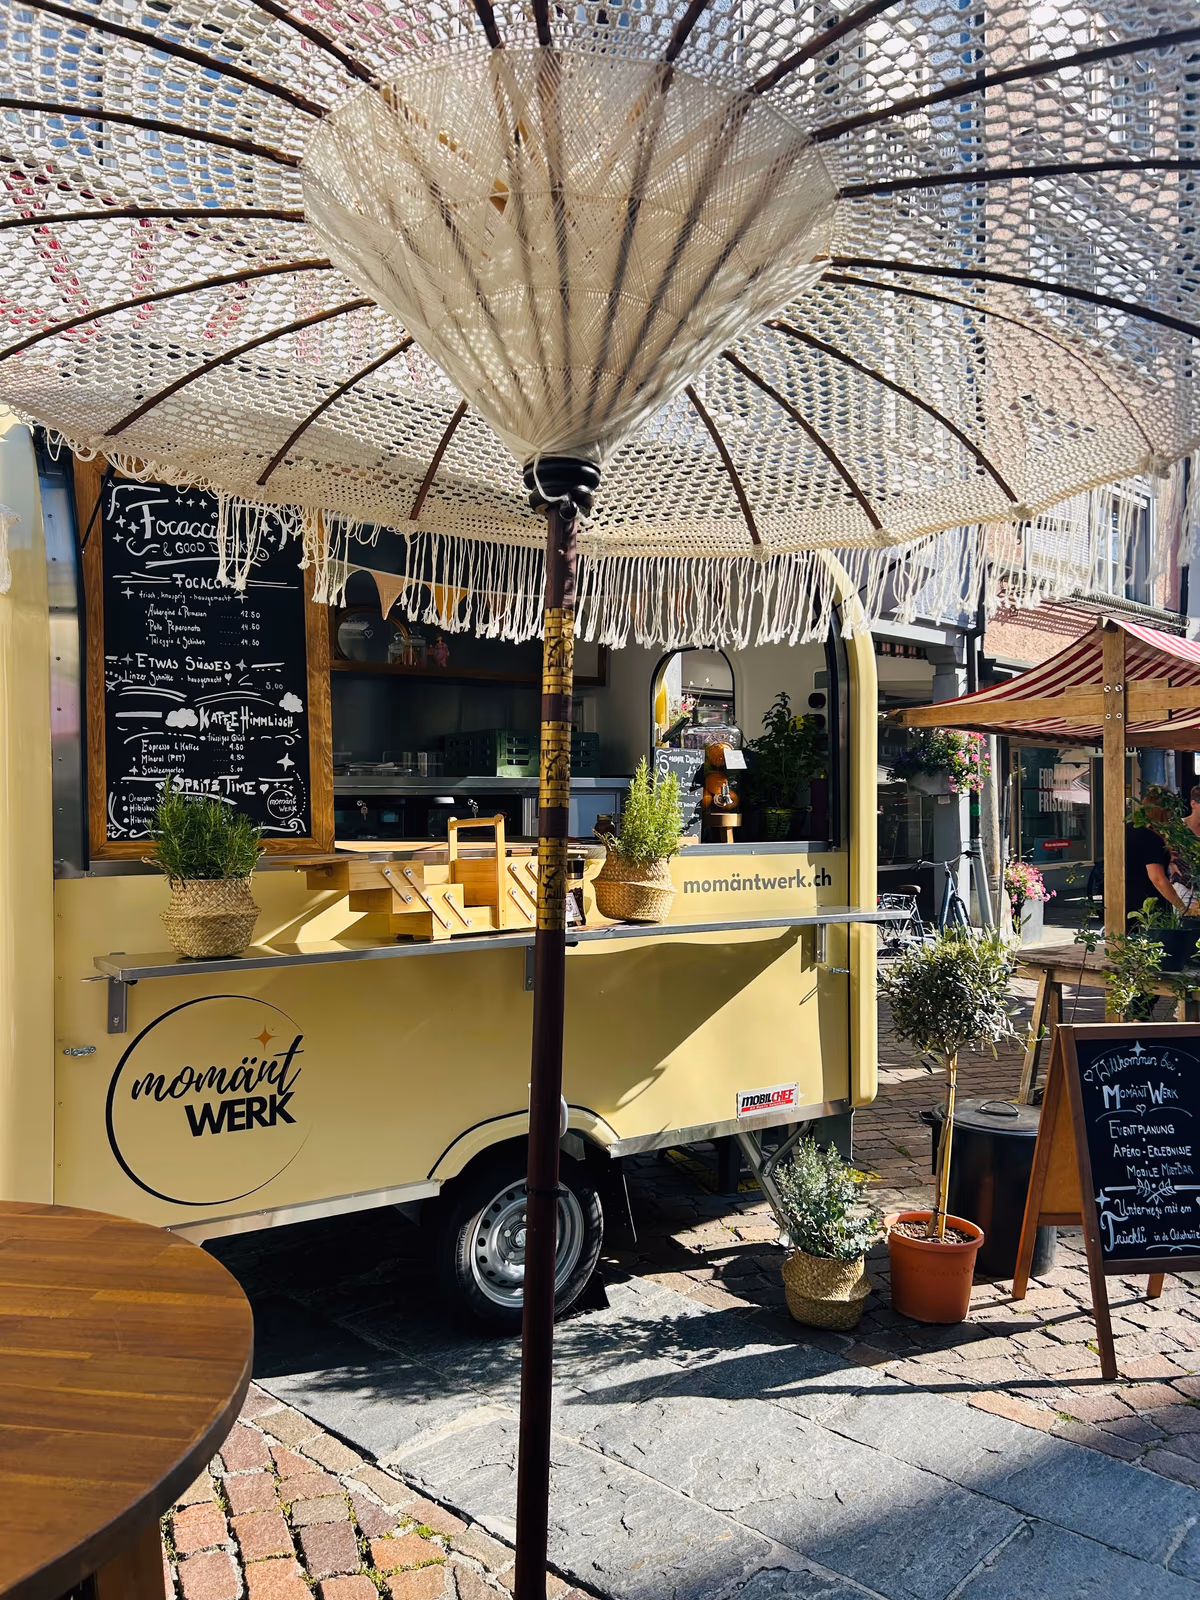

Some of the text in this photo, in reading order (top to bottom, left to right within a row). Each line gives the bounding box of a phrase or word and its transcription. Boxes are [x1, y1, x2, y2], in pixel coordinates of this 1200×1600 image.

[175, 542, 205, 554] GOOD
[240, 610, 261, 619] 12.50
[167, 620, 201, 635] Peperonata
[135, 653, 179, 670] ETWAS
[122, 670, 147, 684] Linzer
[141, 739, 170, 753] Espresso
[180, 742, 200, 751] Kaffee
[141, 754, 164, 764] Mineral
[167, 754, 186, 763] (PET)
[684, 867, 832, 894] momäntwerk.ch
[131, 1034, 304, 1102] momänt
[1091, 1055, 1157, 1082] Willkommen
[742, 1088, 794, 1107] MOBILCHEF
[1147, 1081, 1179, 1105] WERK
[184, 1091, 297, 1137] WERK
[1126, 1165, 1160, 1179] MOBILE
[1114, 1199, 1162, 1219] Unterwegs
[1165, 1202, 1178, 1214] mit
